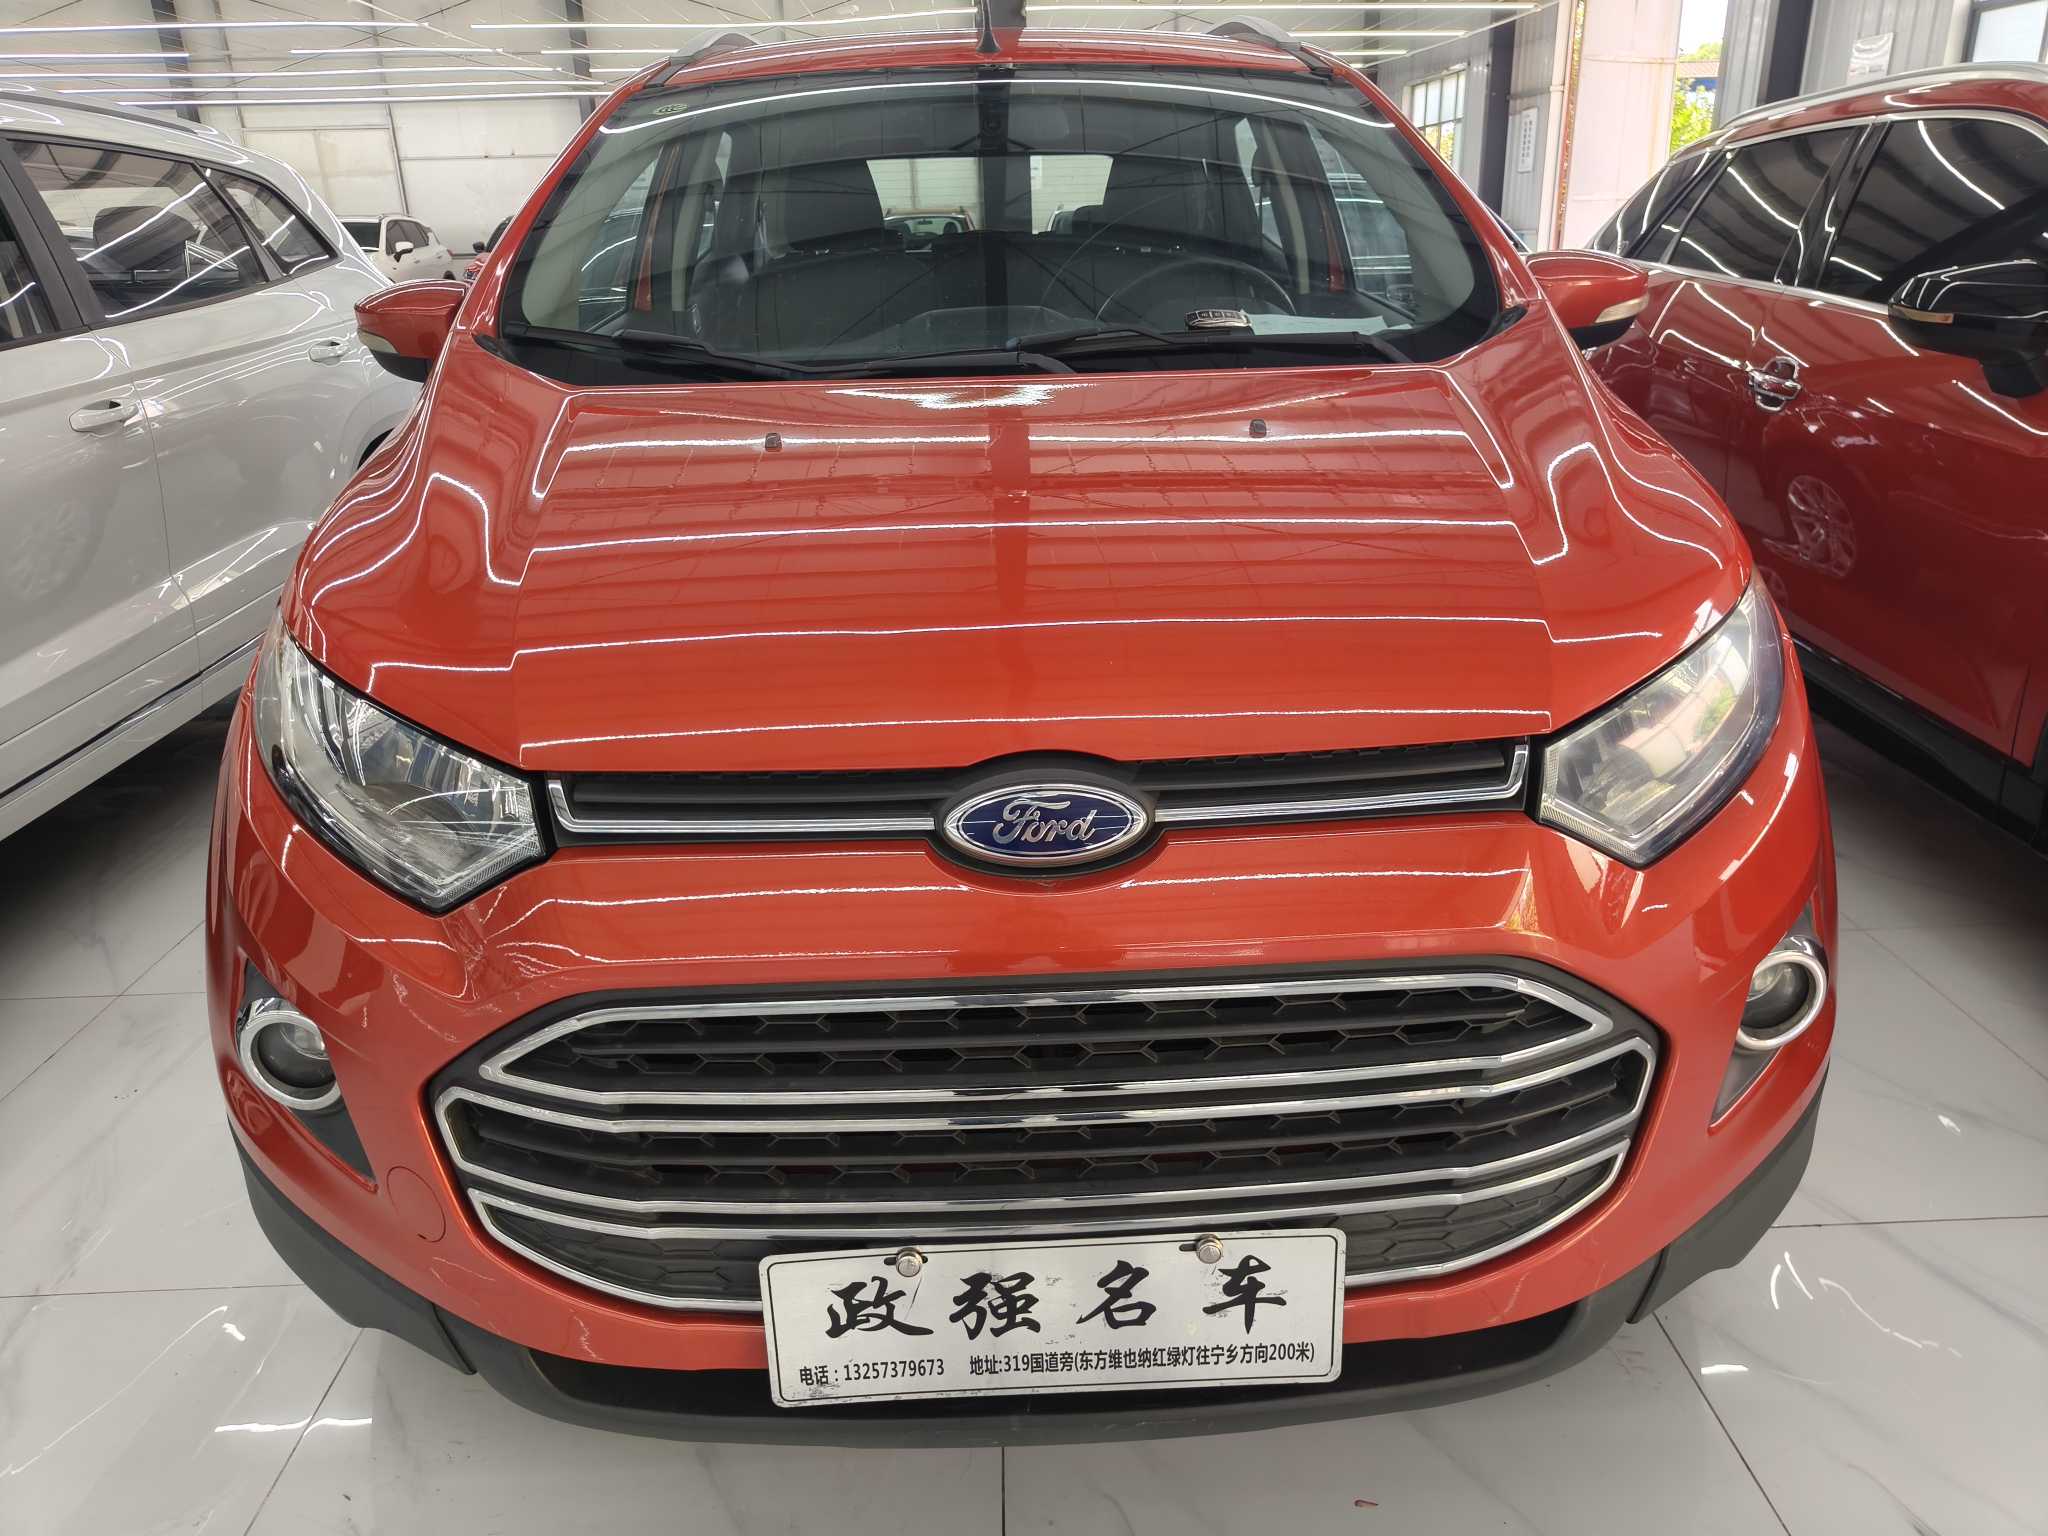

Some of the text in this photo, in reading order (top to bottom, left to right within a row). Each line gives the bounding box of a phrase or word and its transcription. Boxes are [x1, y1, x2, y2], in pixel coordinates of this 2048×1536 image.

[992, 798, 1098, 845] Ford
[825, 1255, 1287, 1340] 政强名车
